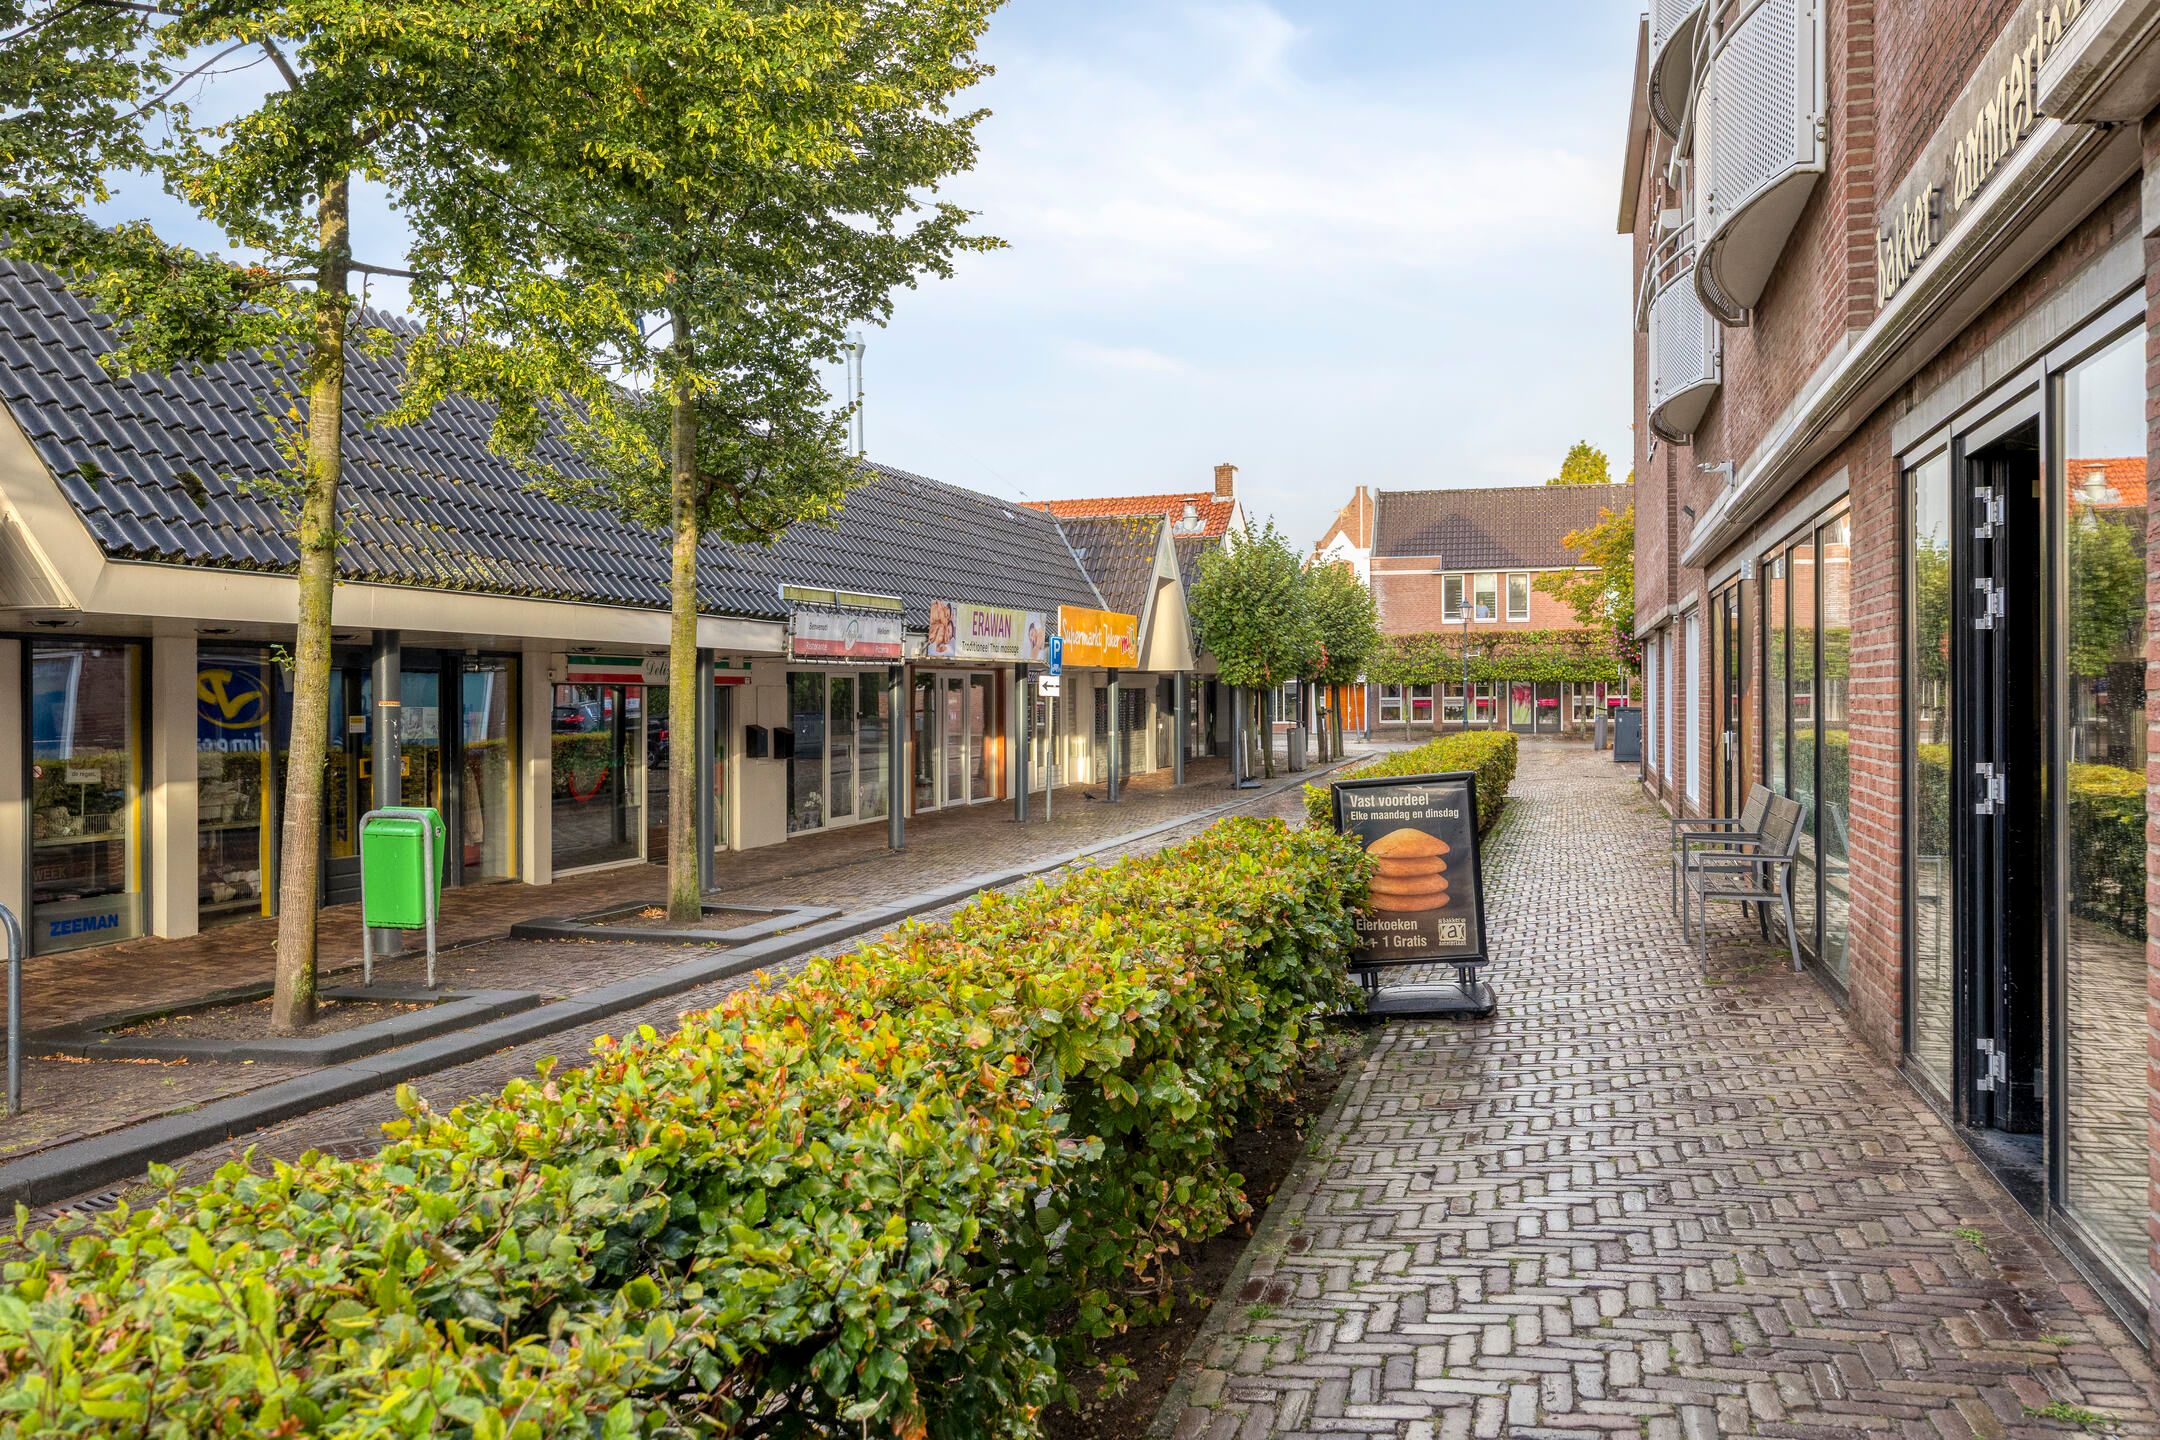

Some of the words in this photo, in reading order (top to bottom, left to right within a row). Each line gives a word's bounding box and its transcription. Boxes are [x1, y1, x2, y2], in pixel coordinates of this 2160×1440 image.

[1876, 182, 1932, 309] bakker
[972, 611, 1012, 638] ERAWAN
[1062, 618, 1102, 652] Supermarkt
[1103, 623, 1121, 653] Joker
[990, 643, 999, 652] Thai
[1000, 645, 1019, 656] massage
[1053, 640, 1061, 659] P
[1350, 794, 1375, 808] Vast
[1378, 792, 1429, 807] voordeel
[1350, 811, 1369, 821] Elke
[1370, 810, 1410, 821] maandag
[1412, 811, 1423, 819] en
[1425, 808, 1460, 819] dinsdag
[50, 913, 119, 937] ZEEMAN
[1356, 918, 1418, 931] Eierkoeken
[1382, 935, 1389, 948] 1
[1393, 935, 1428, 948] Gratis
